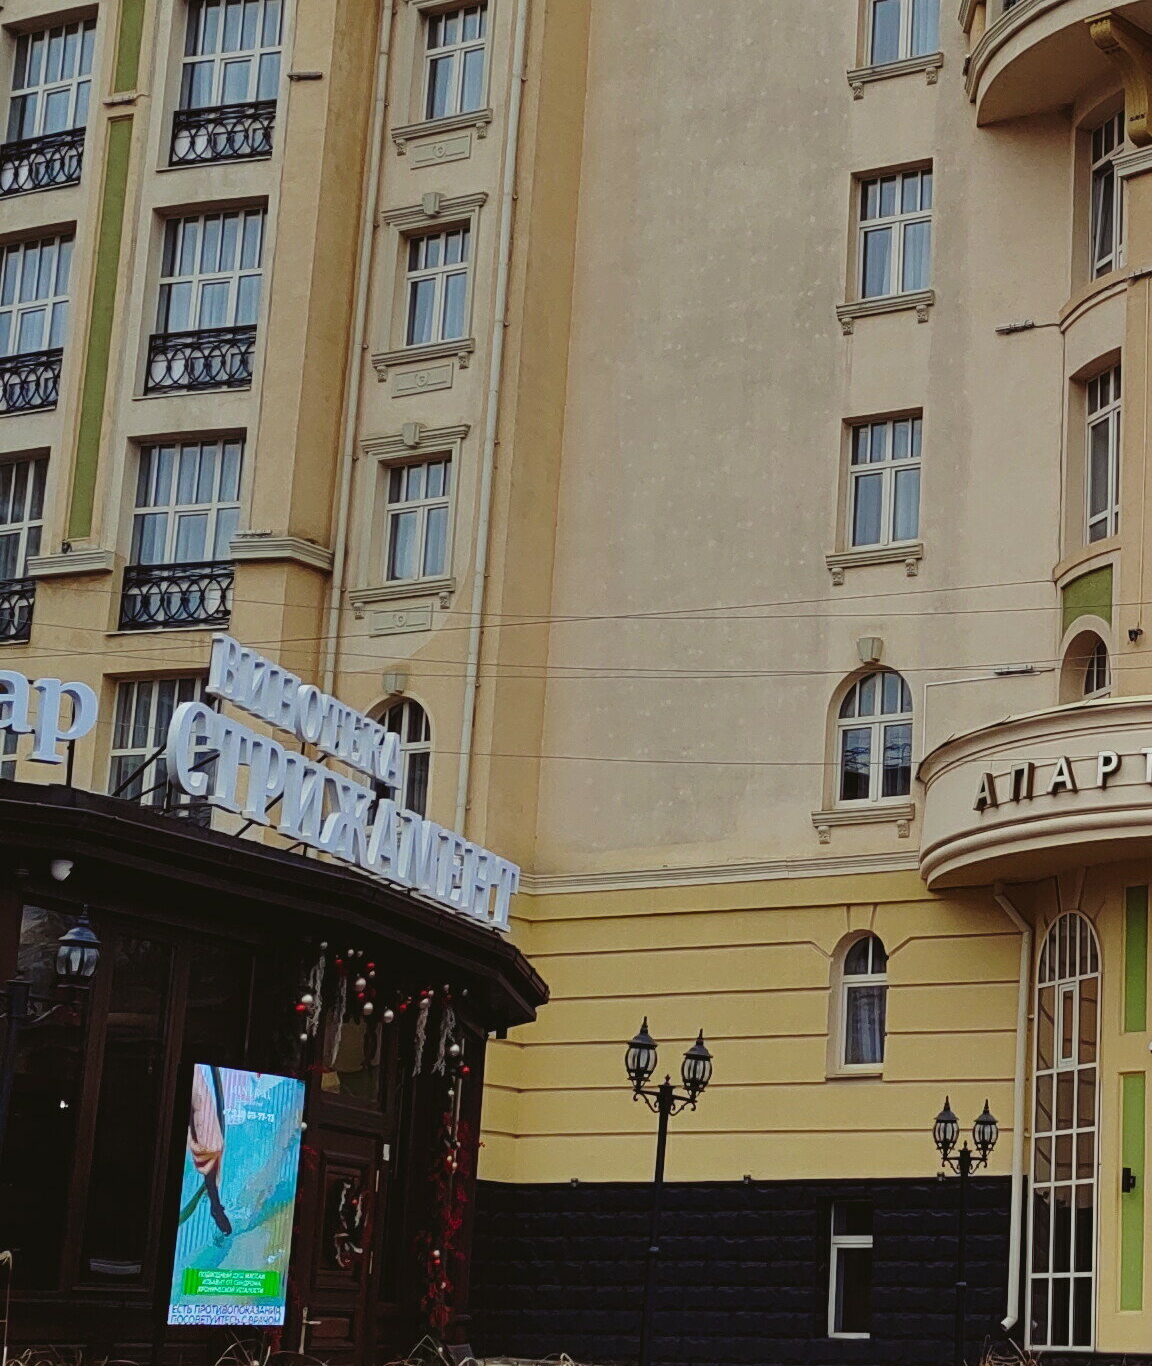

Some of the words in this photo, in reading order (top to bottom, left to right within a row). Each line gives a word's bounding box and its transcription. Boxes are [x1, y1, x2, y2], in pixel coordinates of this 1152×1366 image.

[205, 633, 400, 790] ВИНОТЕКА
[167, 701, 521, 933] СТРИЖАМЕНТ
[172, 1304, 192, 1315] ЕСТЬ
